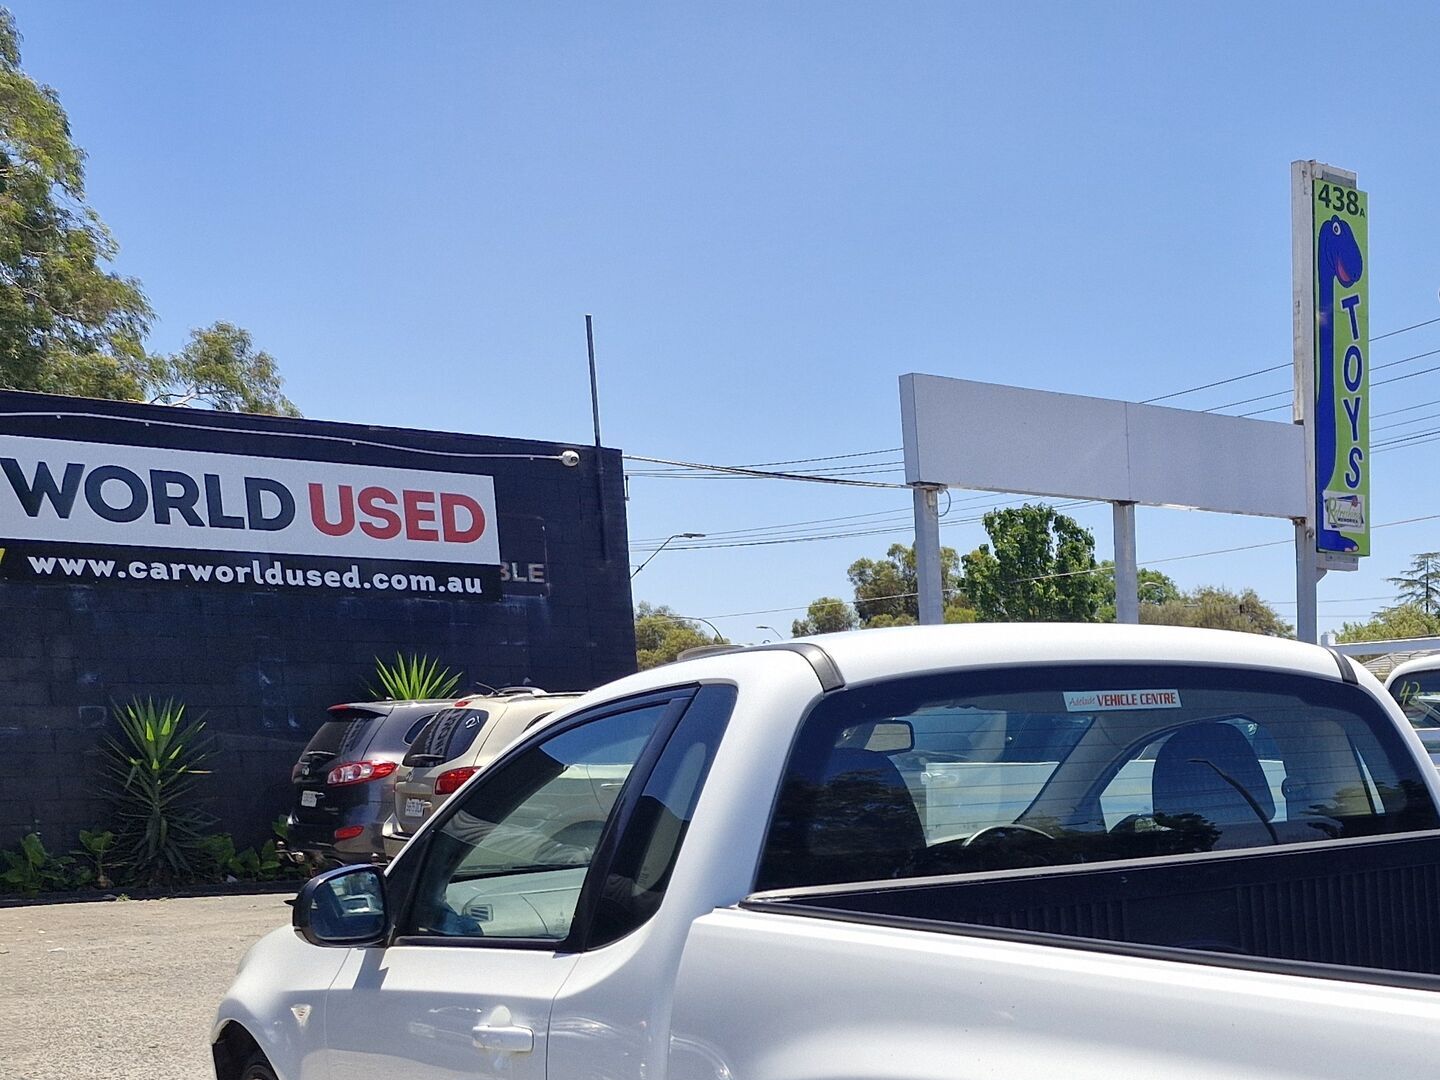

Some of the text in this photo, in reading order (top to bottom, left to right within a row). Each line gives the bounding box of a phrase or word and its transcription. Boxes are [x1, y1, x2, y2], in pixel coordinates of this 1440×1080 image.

[1341, 293, 1363, 489] TOYS
[0, 458, 486, 543] WORLD USED
[28, 556, 482, 594] www.carworldused.com.au
[1096, 694, 1138, 706] VEHICLE
[1140, 693, 1176, 705] CENTRE
